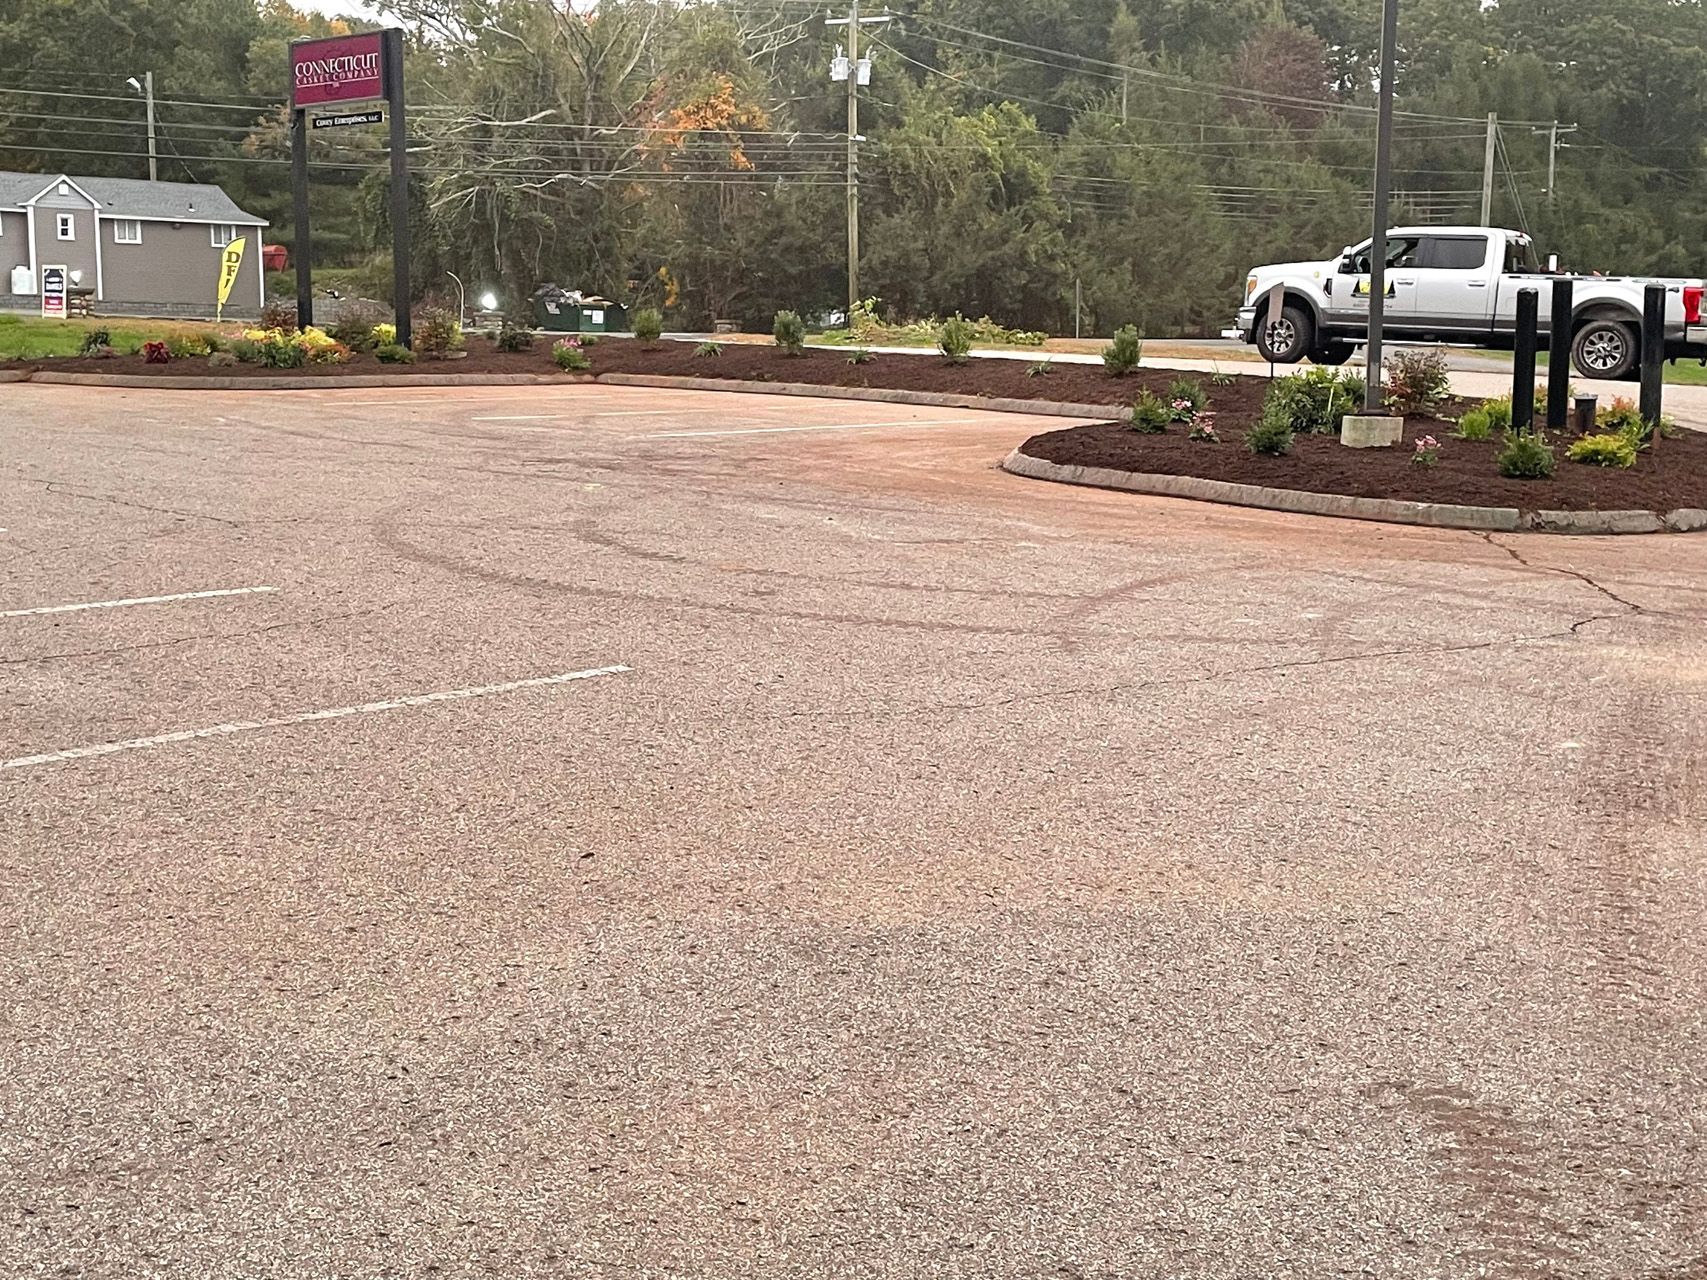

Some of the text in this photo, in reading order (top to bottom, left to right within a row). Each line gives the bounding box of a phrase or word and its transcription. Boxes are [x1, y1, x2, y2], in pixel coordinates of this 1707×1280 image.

[295, 53, 378, 77] CONNECTICUT
[296, 73, 331, 85] CASKET
[333, 68, 379, 80] COMPANY
